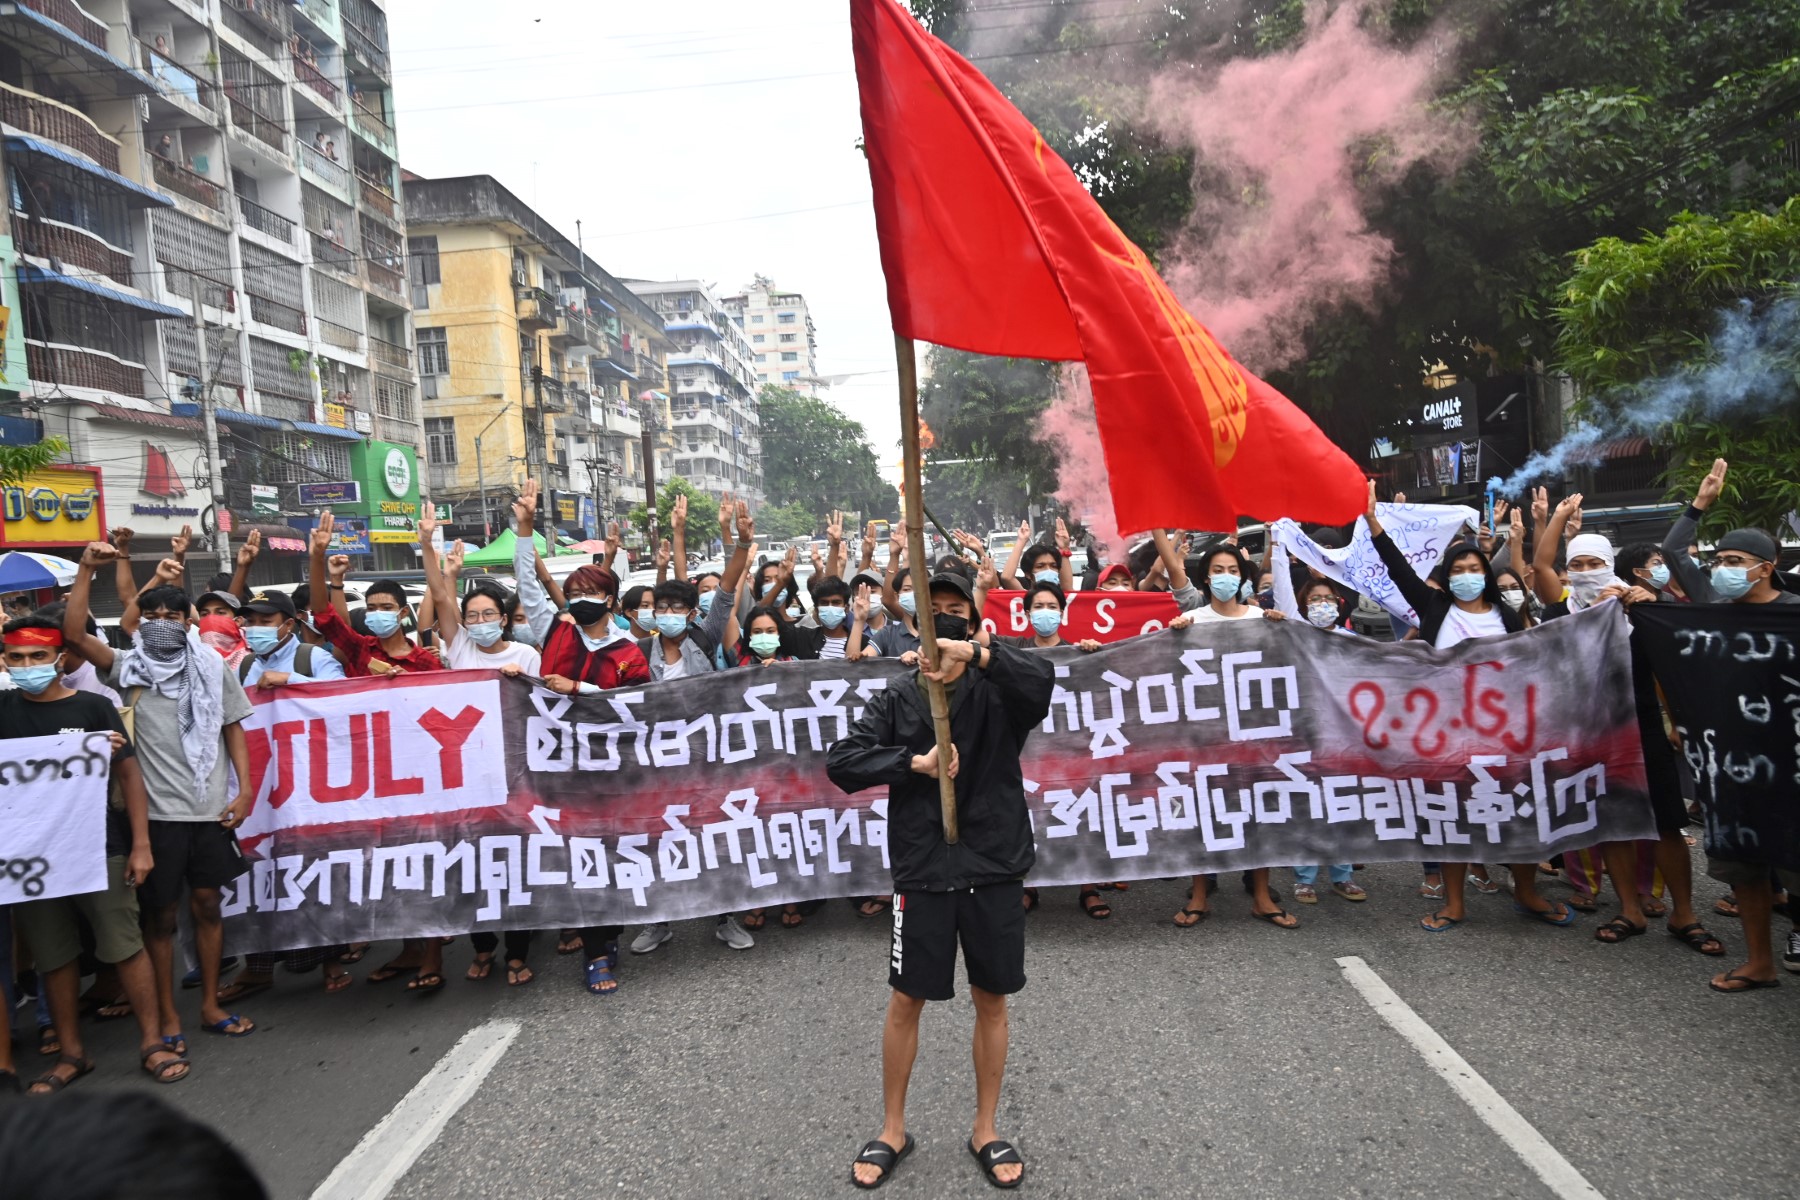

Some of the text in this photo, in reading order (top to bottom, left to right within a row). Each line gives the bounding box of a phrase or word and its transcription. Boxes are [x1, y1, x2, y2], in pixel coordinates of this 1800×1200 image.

[1423, 396, 1462, 421] CANAL+
[1443, 415, 1463, 430] STORE
[10, 491, 22, 517] 1
[34, 499, 60, 512] STOP
[267, 704, 486, 810] JULY
[891, 893, 906, 975] SPIRIT
